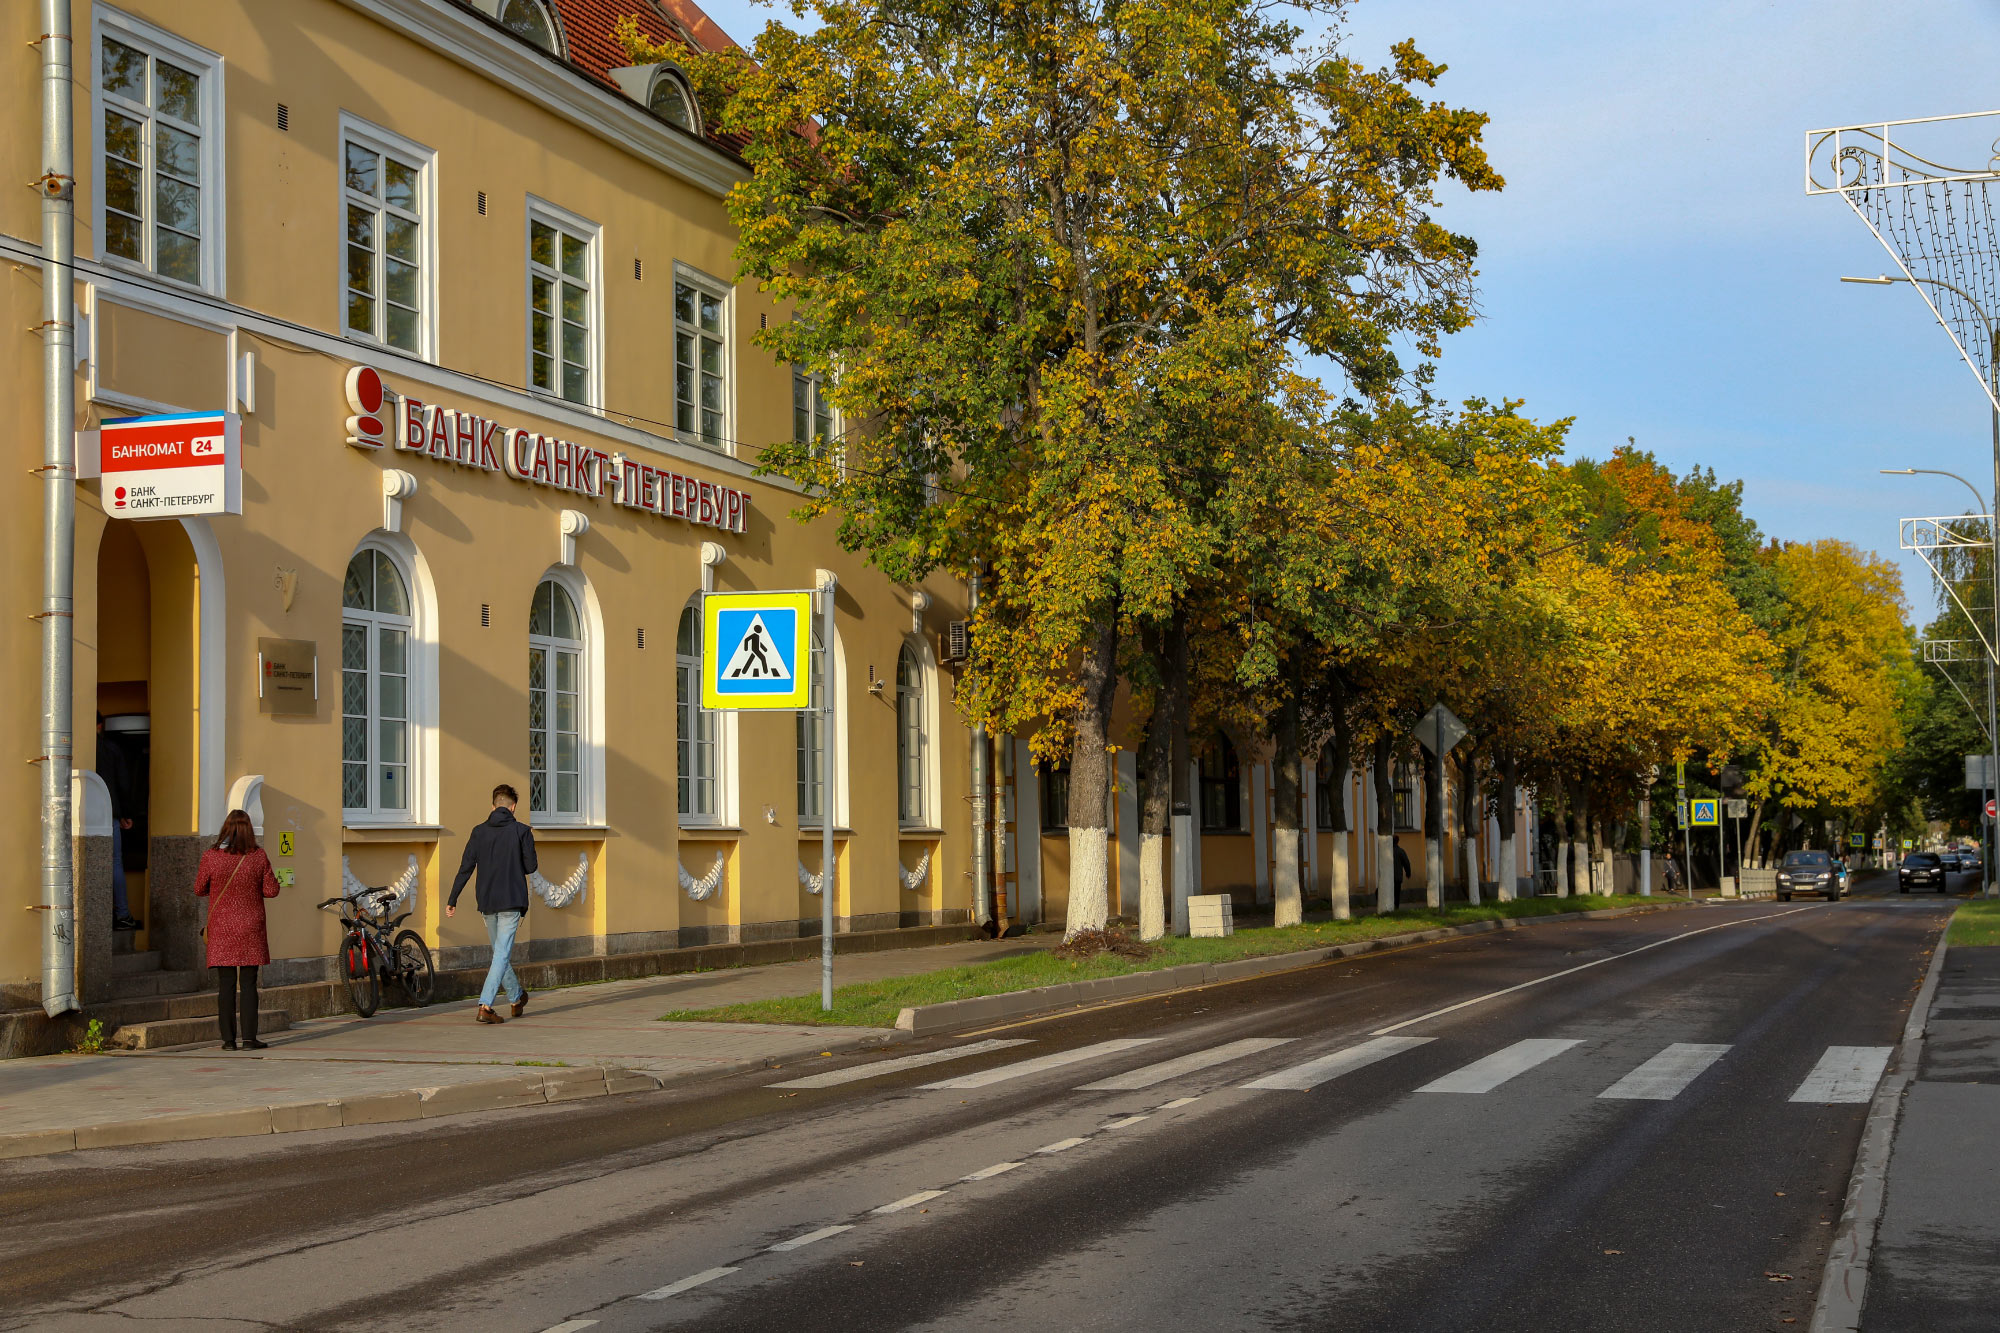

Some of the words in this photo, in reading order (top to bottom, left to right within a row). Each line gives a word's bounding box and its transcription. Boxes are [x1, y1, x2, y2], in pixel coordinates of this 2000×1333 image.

[112, 441, 185, 459] БАНКОМАТ
[195, 440, 213, 453] 24
[401, 397, 500, 471] БАНК
[509, 428, 752, 533] САНКТ-ПЕТЕРБУРГ
[131, 486, 156, 497] БАНК
[131, 494, 215, 509] САНКТ-ПЕТЕРБУРГ
